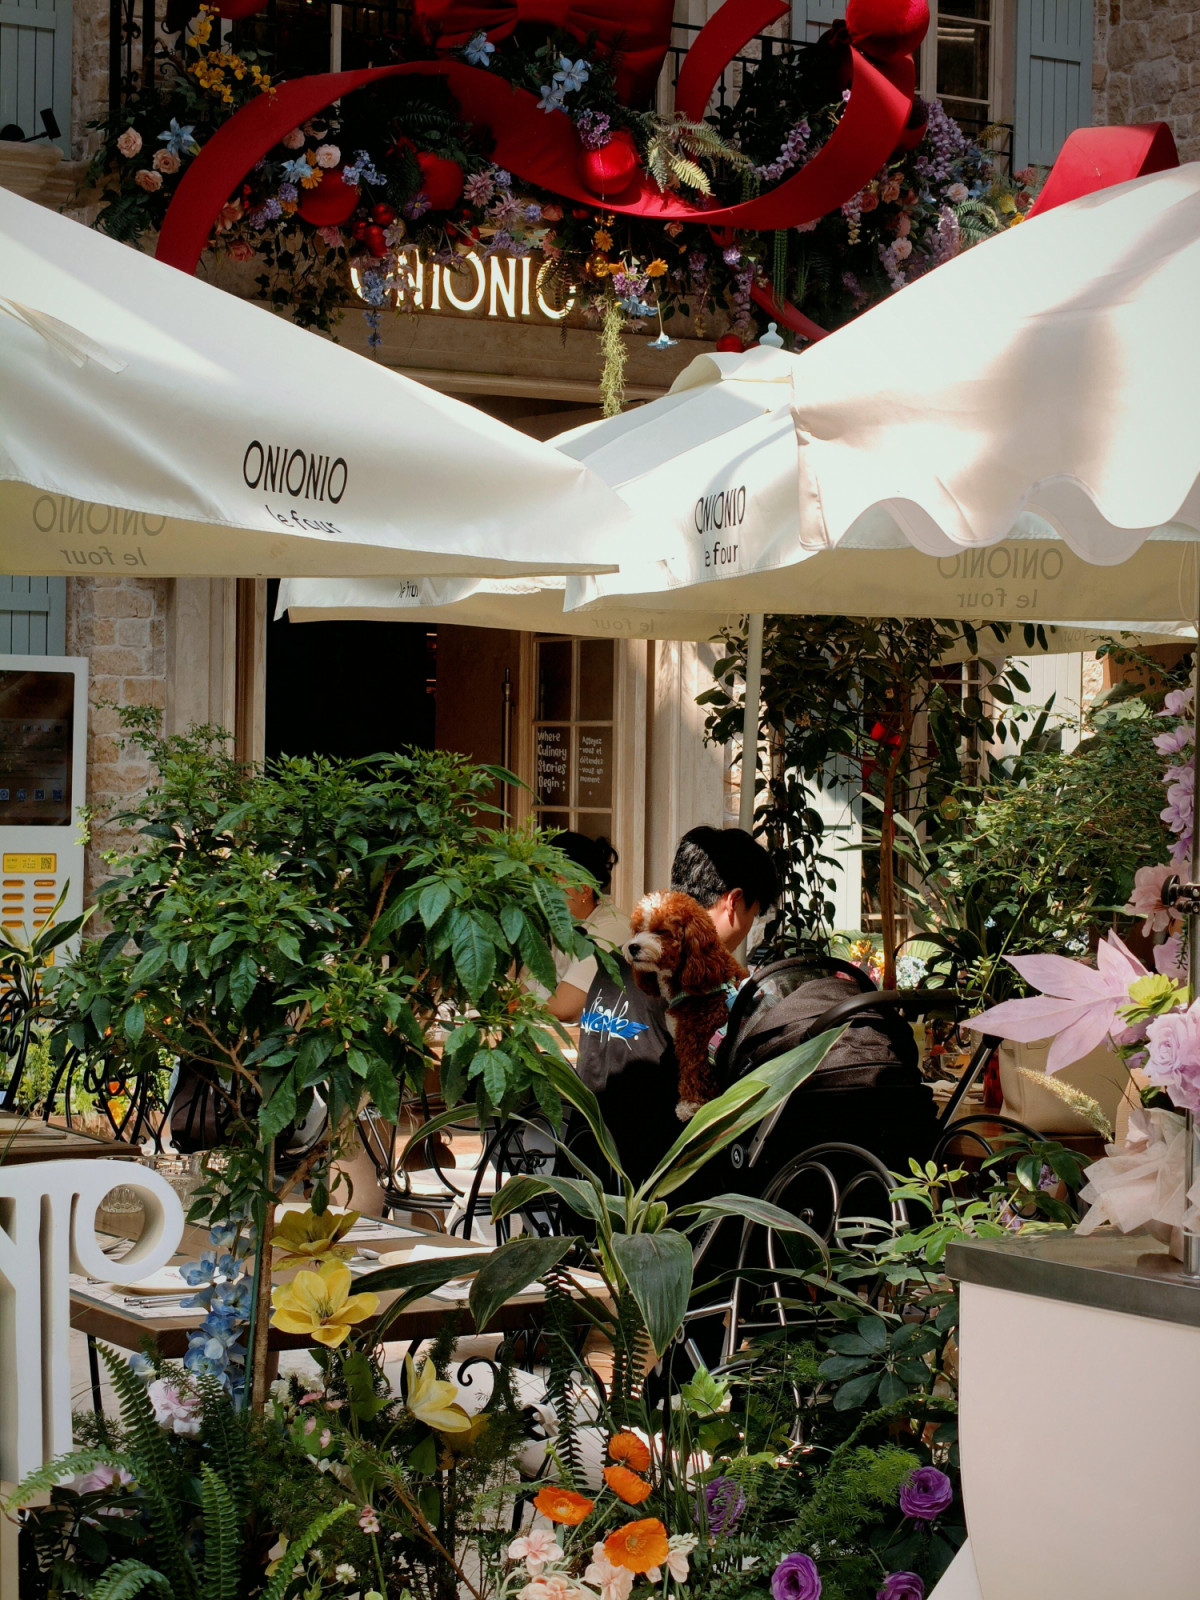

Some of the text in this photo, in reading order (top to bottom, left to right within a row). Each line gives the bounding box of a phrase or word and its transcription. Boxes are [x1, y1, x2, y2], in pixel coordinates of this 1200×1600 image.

[243, 440, 348, 504] ONIONIO
[265, 504, 342, 533] le four
[695, 485, 746, 534] ONIONIO
[713, 541, 738, 565] four
[537, 744, 567, 761] Culinary
[538, 759, 567, 775] Stories
